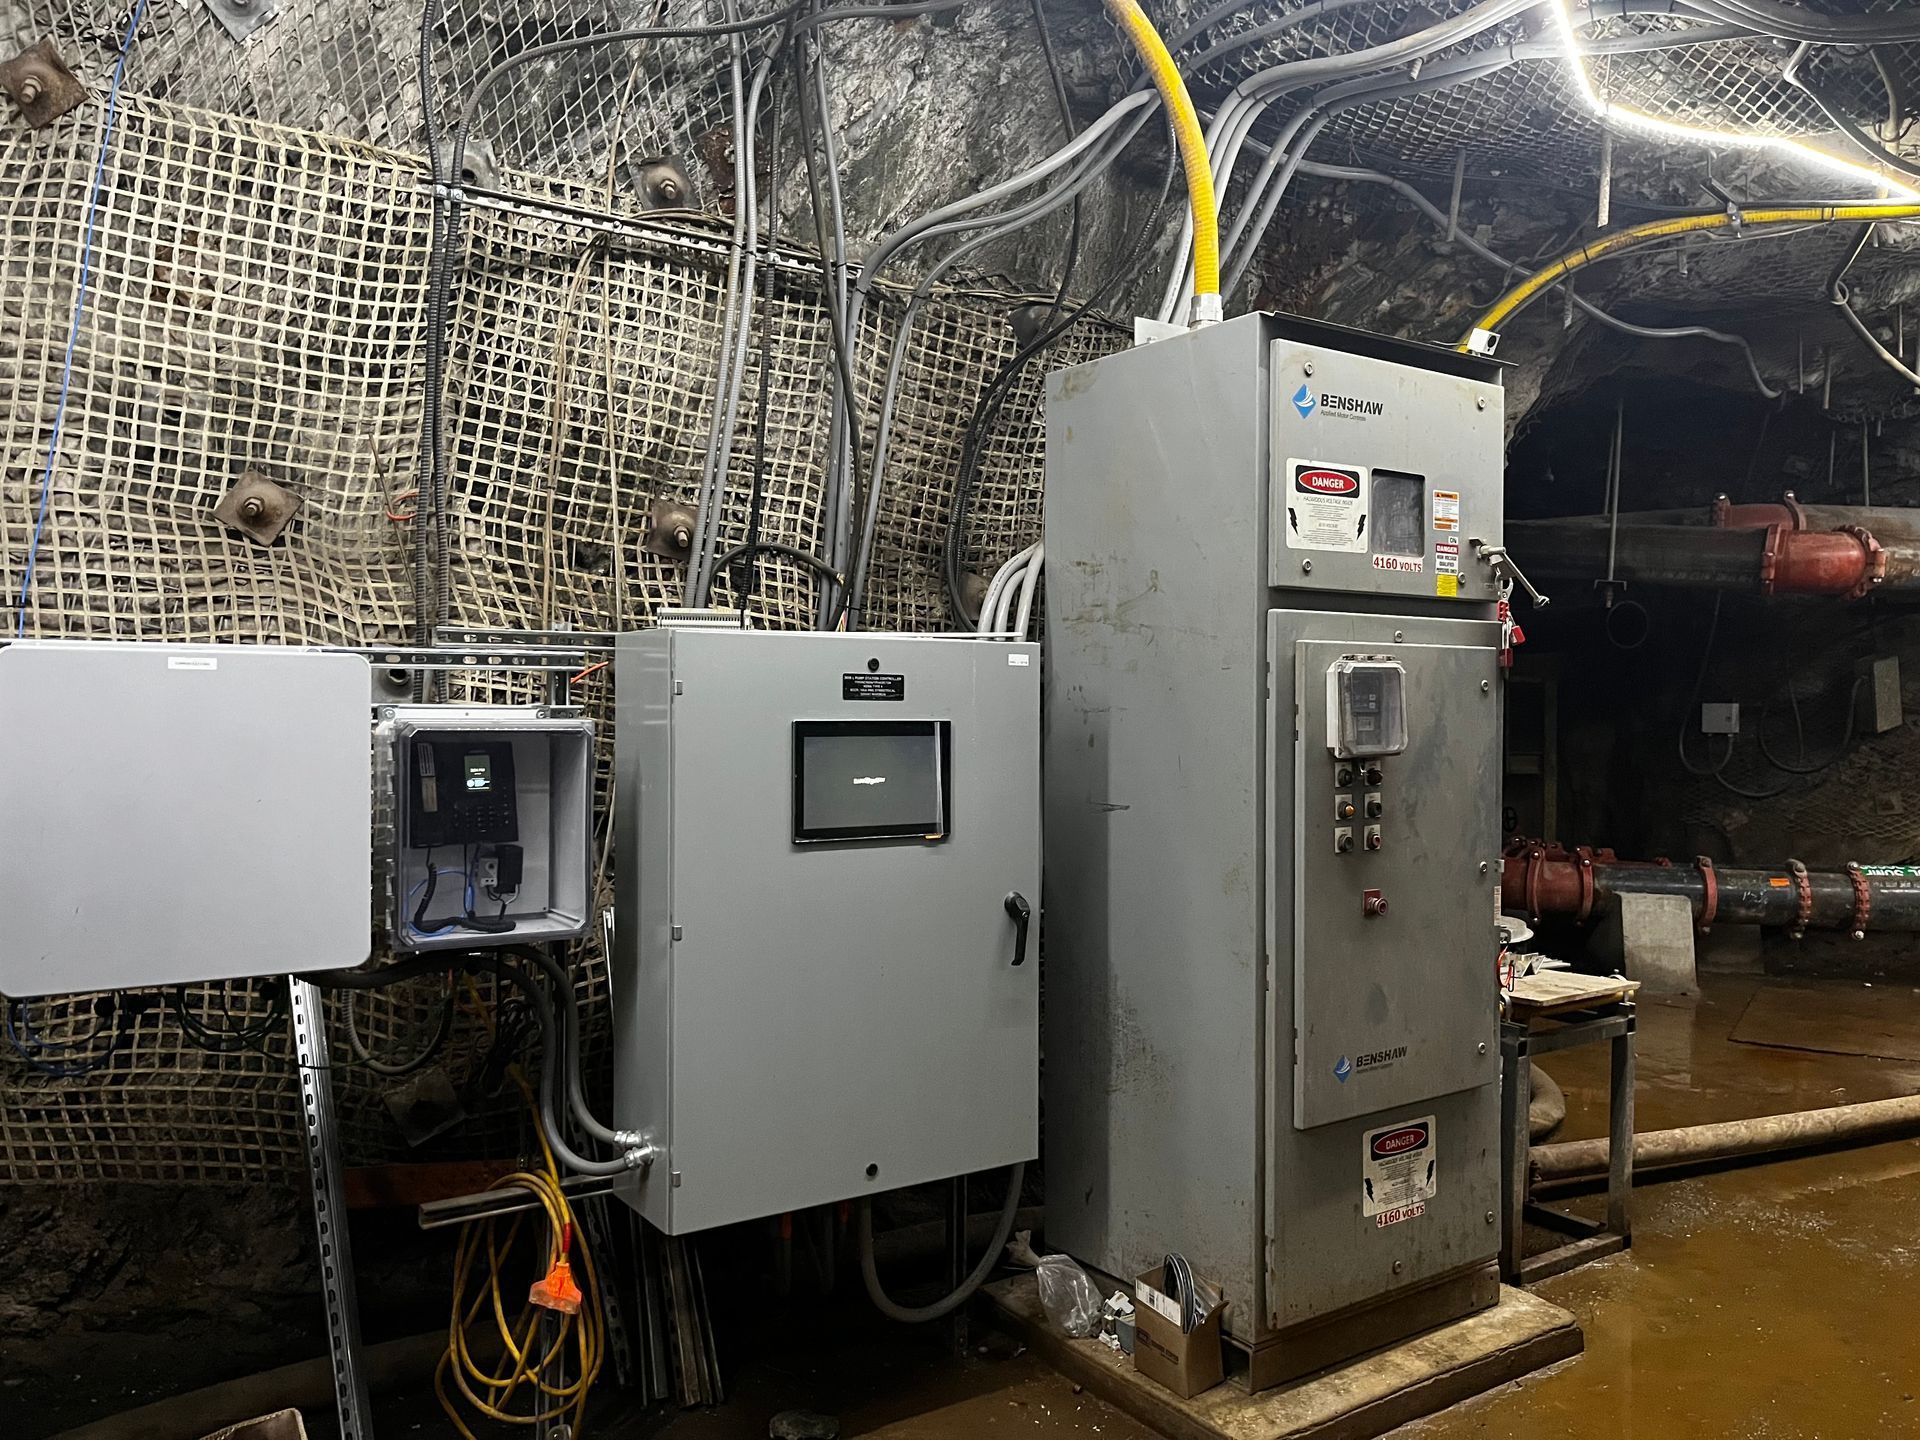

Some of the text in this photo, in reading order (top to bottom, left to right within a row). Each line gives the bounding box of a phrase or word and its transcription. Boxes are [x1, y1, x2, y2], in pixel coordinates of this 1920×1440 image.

[1320, 393, 1384, 416] BENSHAW
[1312, 476, 1344, 489] DANGER
[1436, 545, 1458, 554] DANGER
[1373, 556, 1422, 572] 4160 VOLTS
[1356, 1045, 1408, 1068] BENSHAW
[1385, 1134, 1415, 1150] DANGER
[1377, 1204, 1425, 1226] 4160 VOLTS
